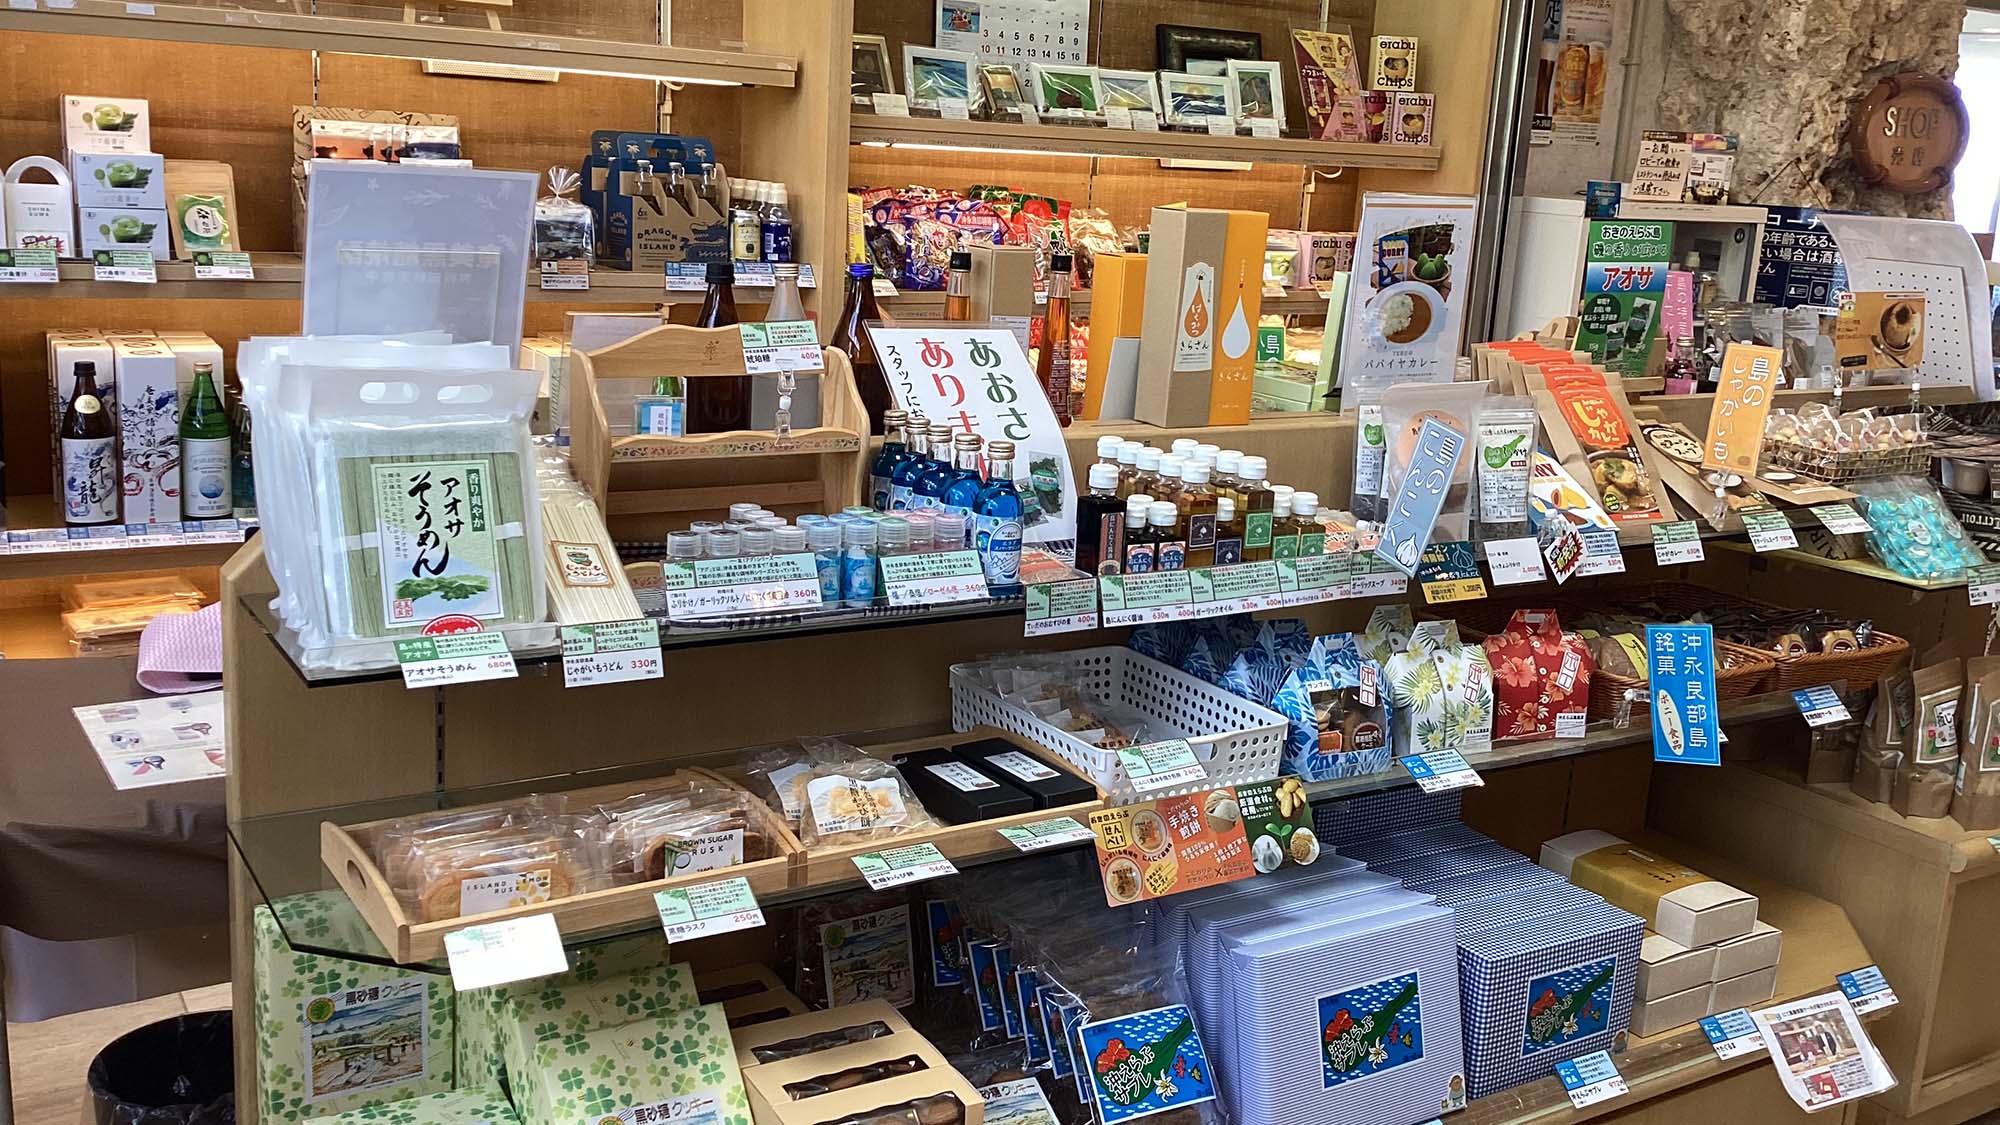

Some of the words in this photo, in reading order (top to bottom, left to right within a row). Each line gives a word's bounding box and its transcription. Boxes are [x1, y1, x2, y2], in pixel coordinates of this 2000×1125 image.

[1074, 22, 1079, 31] 2
[998, 31, 1004, 39] 4
[1014, 32, 1019, 40] 5
[1029, 33, 1035, 42] 6
[1044, 35, 1049, 43] 7
[1058, 36, 1064, 44] 8
[1073, 37, 1079, 46] 9
[1380, 39, 1416, 50] erabu
[981, 45, 990, 54] 10
[997, 46, 1005, 55] 11
[1012, 47, 1021, 56] 12
[1027, 48, 1036, 57] 13
[1042, 50, 1051, 59] 14
[1056, 51, 1065, 60] 15
[1071, 52, 1080, 61] 16
[1376, 76, 1413, 89] chips
[1365, 94, 1392, 104] rabu
[1398, 97, 1432, 106] erabu
[1884, 106, 1943, 139] SHOP
[1395, 130, 1429, 145] chips
[638, 228, 677, 241] DRAGON
[1602, 225, 1662, 240] おきのえらぶ島
[1312, 238, 1341, 249] erabu
[1603, 265, 1654, 290] アオサ
[746, 355, 770, 363] 琥珀糖
[1364, 358, 1439, 369] パパイヤカレー
[964, 338, 1031, 440] あおさ
[1742, 356, 1770, 407] 島の
[1712, 355, 1747, 464] じゃがいも
[1588, 428, 1620, 443] カレー
[1426, 435, 1457, 495] 島の
[1386, 426, 1440, 546] にんにく
[440, 477, 465, 538] アオサ
[467, 472, 484, 528] 香り爽やか
[408, 471, 450, 578] そうめん
[1657, 550, 1681, 558] じゃがカレー
[1352, 580, 1385, 589] ガーリックスープ
[794, 590, 818, 598] 360円
[1196, 604, 1233, 616] ガーリックオイル
[1077, 616, 1095, 624] 400円
[1105, 616, 1143, 625] 島にんにく醤油
[1152, 612, 1169, 620] 630円
[403, 651, 432, 659] アオサ
[1655, 632, 1676, 676] 銘菓
[405, 663, 477, 677] アオサそうめん
[567, 662, 623, 675] じゃがいもうどん
[631, 659, 657, 668] 330円
[1681, 633, 1708, 749] 沖永良部島
[1660, 694, 1682, 751] ポニー食品
[1169, 806, 1198, 828] 手焼き
[1104, 826, 1121, 835] せん
[1179, 821, 1202, 840] 煎餅
[678, 837, 706, 848] BROWN
[707, 833, 734, 844] SUGAR
[1108, 836, 1124, 845] べい
[692, 845, 725, 856] RUSK
[467, 881, 507, 892] ISLAND
[515, 875, 549, 884] LEMON
[494, 887, 520, 895] RUSK
[668, 922, 706, 935] 黒糖ラスク
[733, 913, 759, 923] 250円
[852, 917, 877, 931] 黒砂糖
[344, 986, 381, 1007] 黒砂糖
[381, 982, 423, 997] クッキー
[1531, 993, 1573, 1031] 沖えらぶ
[1532, 1015, 1565, 1043] サブレ
[1329, 1015, 1375, 1061] 沖えらぶ
[1332, 1039, 1370, 1074] サブレ
[1104, 1045, 1156, 1093] 沖えらぶ
[978, 1086, 1003, 1100] 砂糖
[1112, 1072, 1154, 1105] サブレ
[633, 1105, 671, 1124] 黒砂糖
[671, 1097, 714, 1116] クッキー
